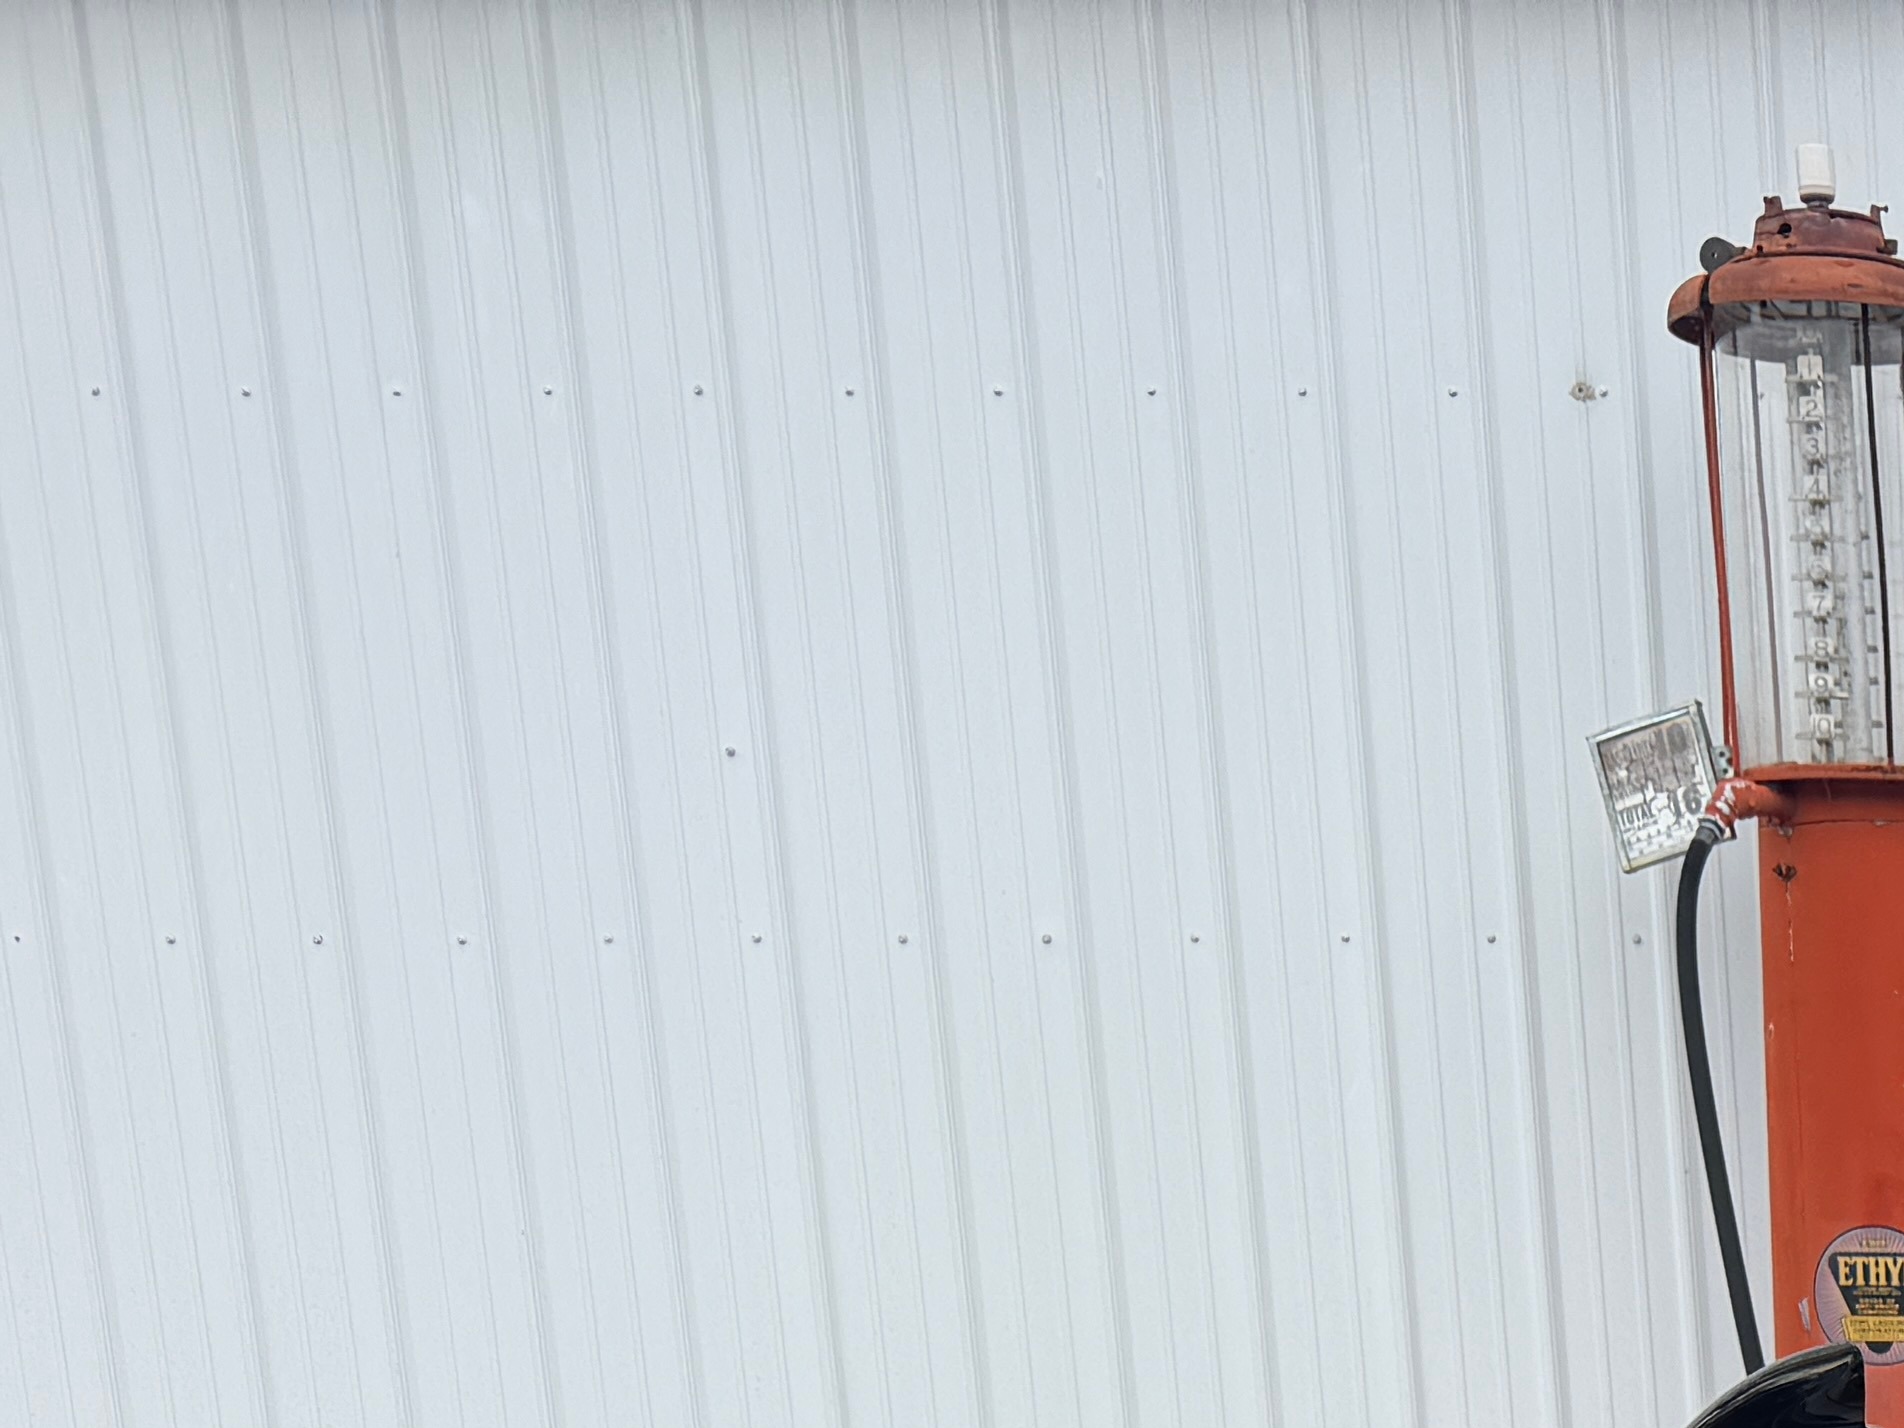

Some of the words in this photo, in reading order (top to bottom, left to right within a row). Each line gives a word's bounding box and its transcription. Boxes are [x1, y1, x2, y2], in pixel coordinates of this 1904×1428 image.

[1805, 400, 1818, 417] 2
[1806, 437, 1819, 454] 3
[1809, 476, 1821, 496] 4
[1812, 594, 1825, 611] 7
[1814, 638, 1828, 658] 8
[1814, 675, 1828, 696] 9
[1812, 715, 1832, 735] 10
